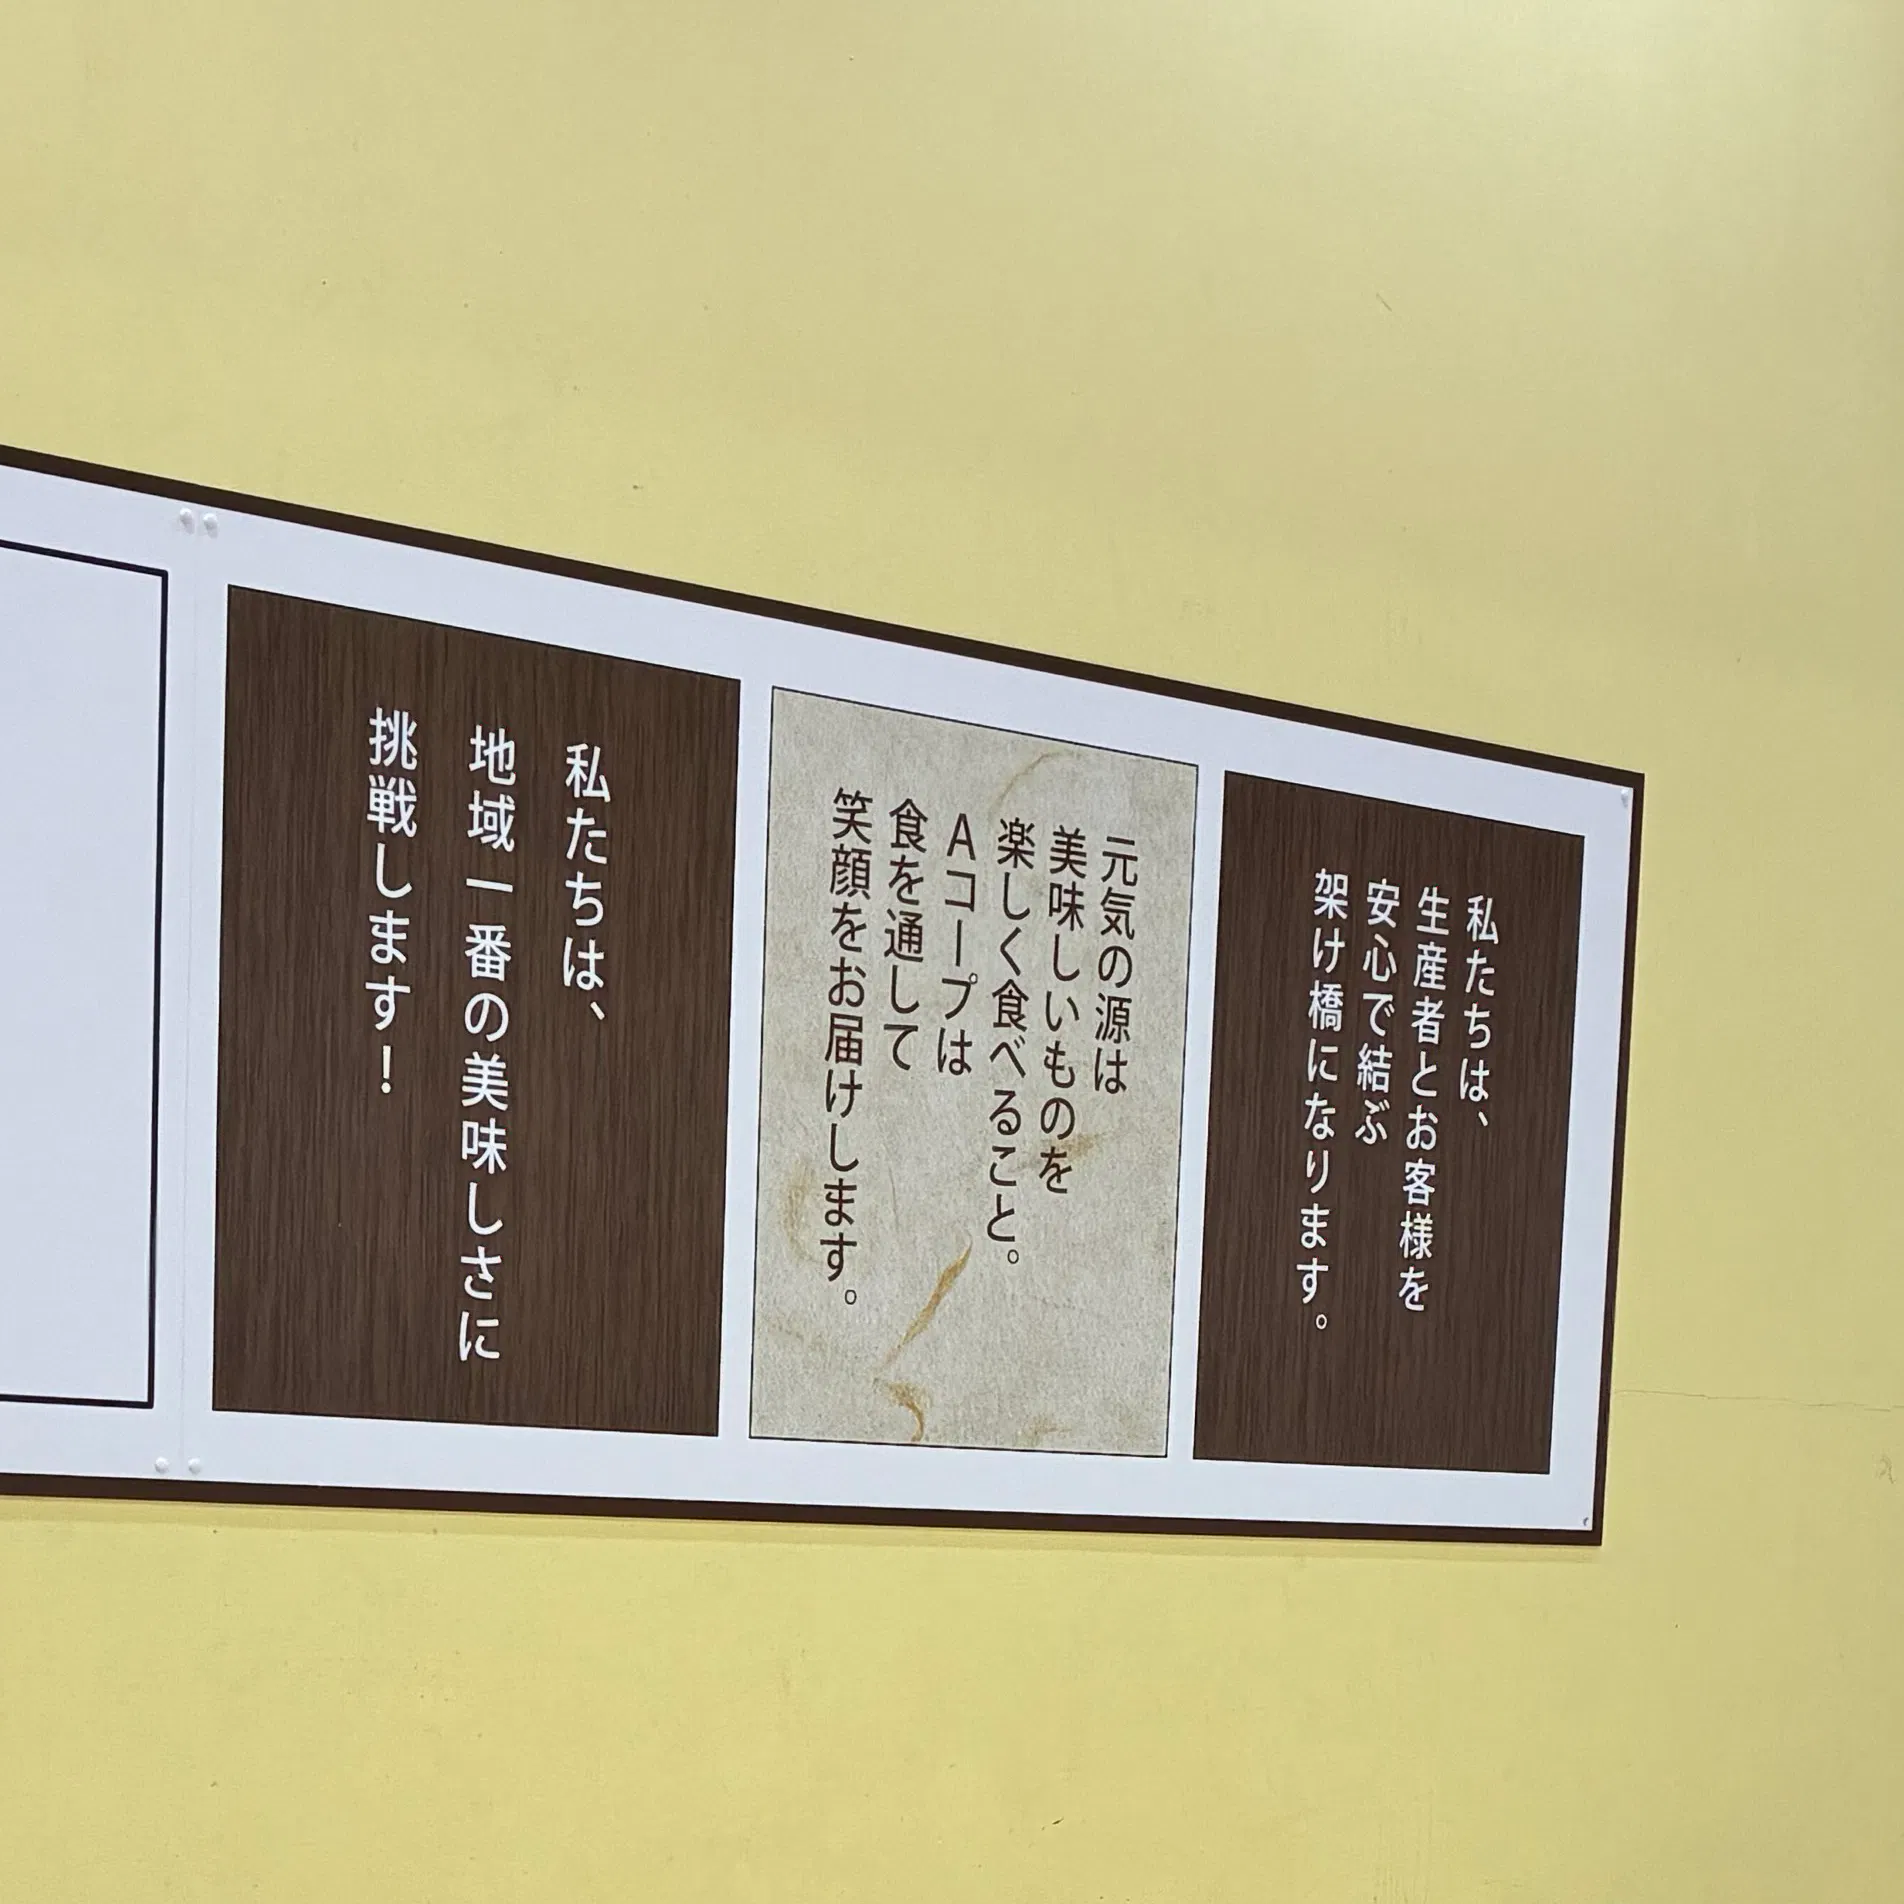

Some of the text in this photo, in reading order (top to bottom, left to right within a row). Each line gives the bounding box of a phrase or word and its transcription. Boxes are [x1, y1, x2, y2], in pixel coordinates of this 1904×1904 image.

[459, 725, 516, 1361] 地域一番の美味しさに
[563, 742, 611, 1020] 私たちは、
[883, 798, 929, 1071] 食を通して
[937, 813, 979, 1076] Aコープは
[986, 817, 1035, 1265] 楽しく食べること。
[1039, 824, 1087, 1194] 美味しいものを
[1094, 836, 1139, 1095] 元気の源は
[1354, 878, 1400, 1145] 安心で結ぶ
[1459, 895, 1499, 1127] 私たちは、
[820, 788, 874, 1306] 笑顔をお届けします。
[1296, 868, 1349, 1330] 架け橋になります。
[1398, 886, 1450, 1310] 生産者とお客様を
